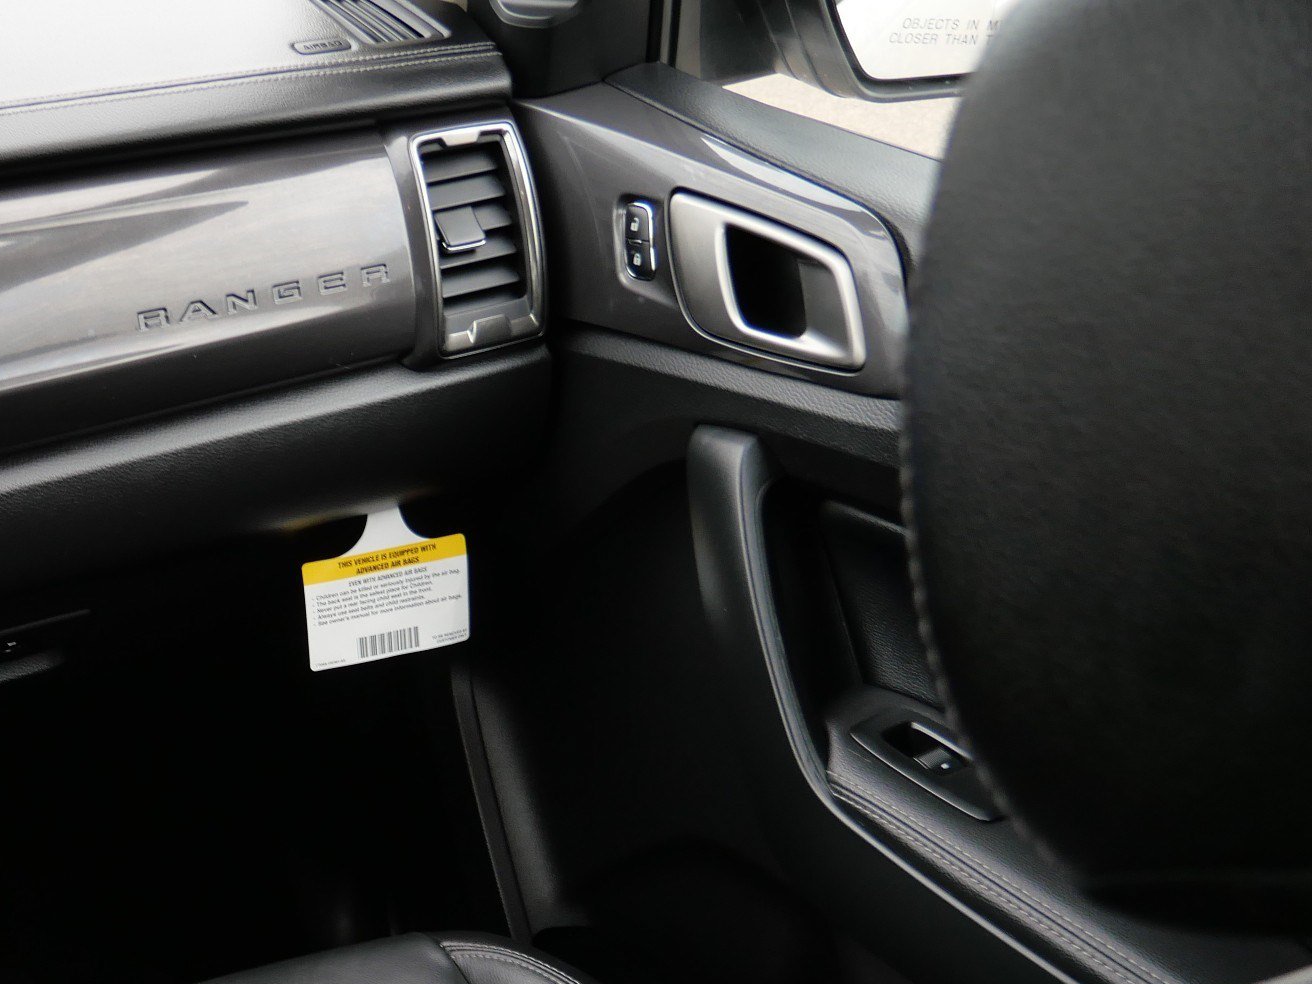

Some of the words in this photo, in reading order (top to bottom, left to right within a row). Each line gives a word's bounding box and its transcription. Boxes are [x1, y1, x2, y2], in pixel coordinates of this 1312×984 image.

[902, 17, 960, 30] OBJECTS
[966, 19, 979, 30] IN
[303, 41, 342, 50] AIRBAG
[889, 32, 938, 45] CLOSER
[945, 33, 979, 45] THAN
[136, 263, 390, 332] RANGER
[338, 560, 352, 569] THIS
[355, 554, 379, 566] VEHICLE
[389, 547, 419, 559] EQUIPPED
[421, 543, 436, 552] WITH
[356, 562, 388, 574] ADVANCED
[390, 560, 401, 569] AIR
[403, 556, 420, 566] BAGS
